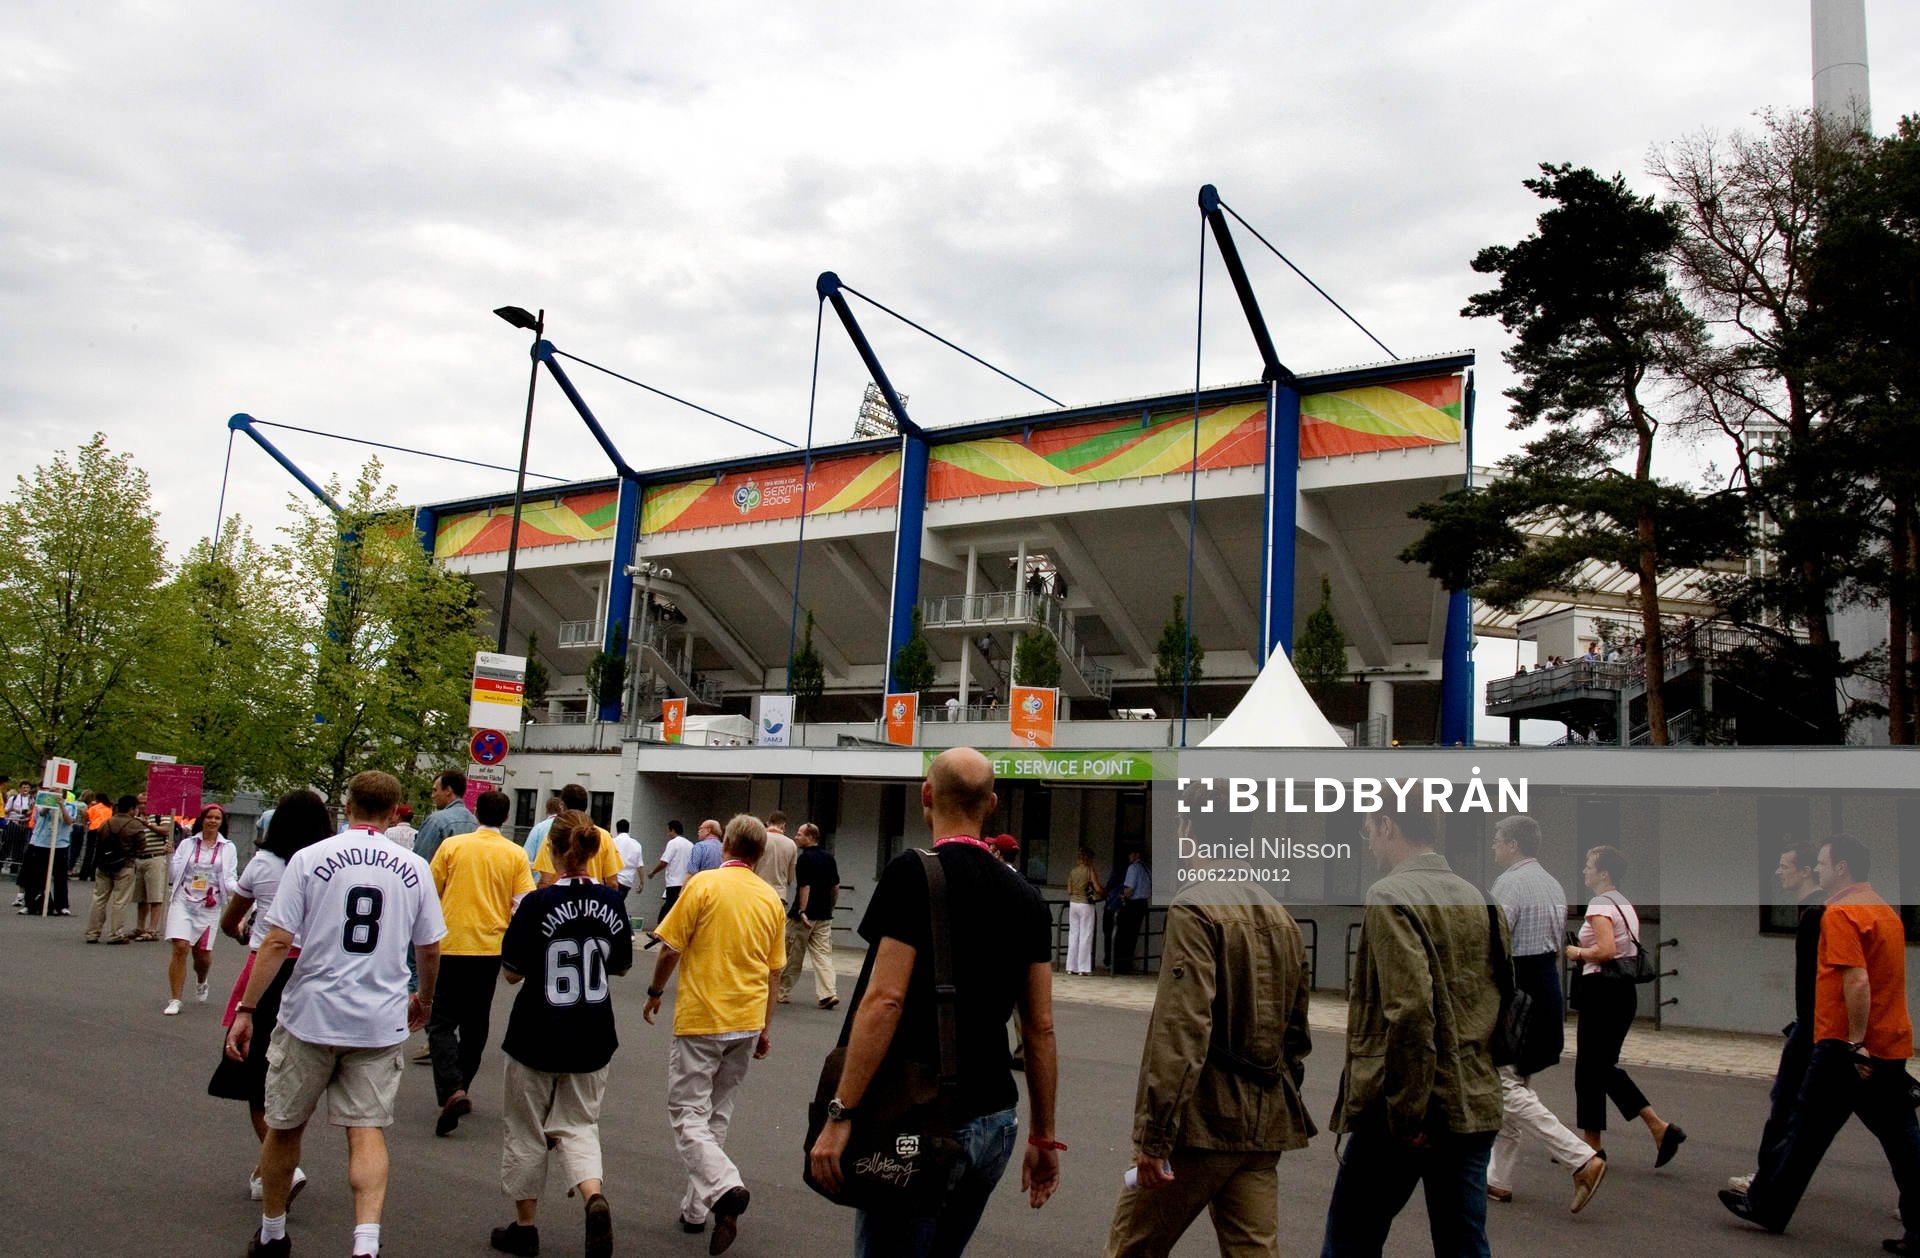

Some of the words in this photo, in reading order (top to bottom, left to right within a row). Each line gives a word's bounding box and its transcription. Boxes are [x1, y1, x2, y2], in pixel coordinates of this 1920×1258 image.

[762, 495, 791, 507] 2006
[1014, 759, 1078, 775] SERVICE
[1082, 759, 1134, 775] POINT
[313, 848, 419, 888] DANDURAND
[341, 884, 385, 956] 8
[545, 936, 611, 1006] 60
